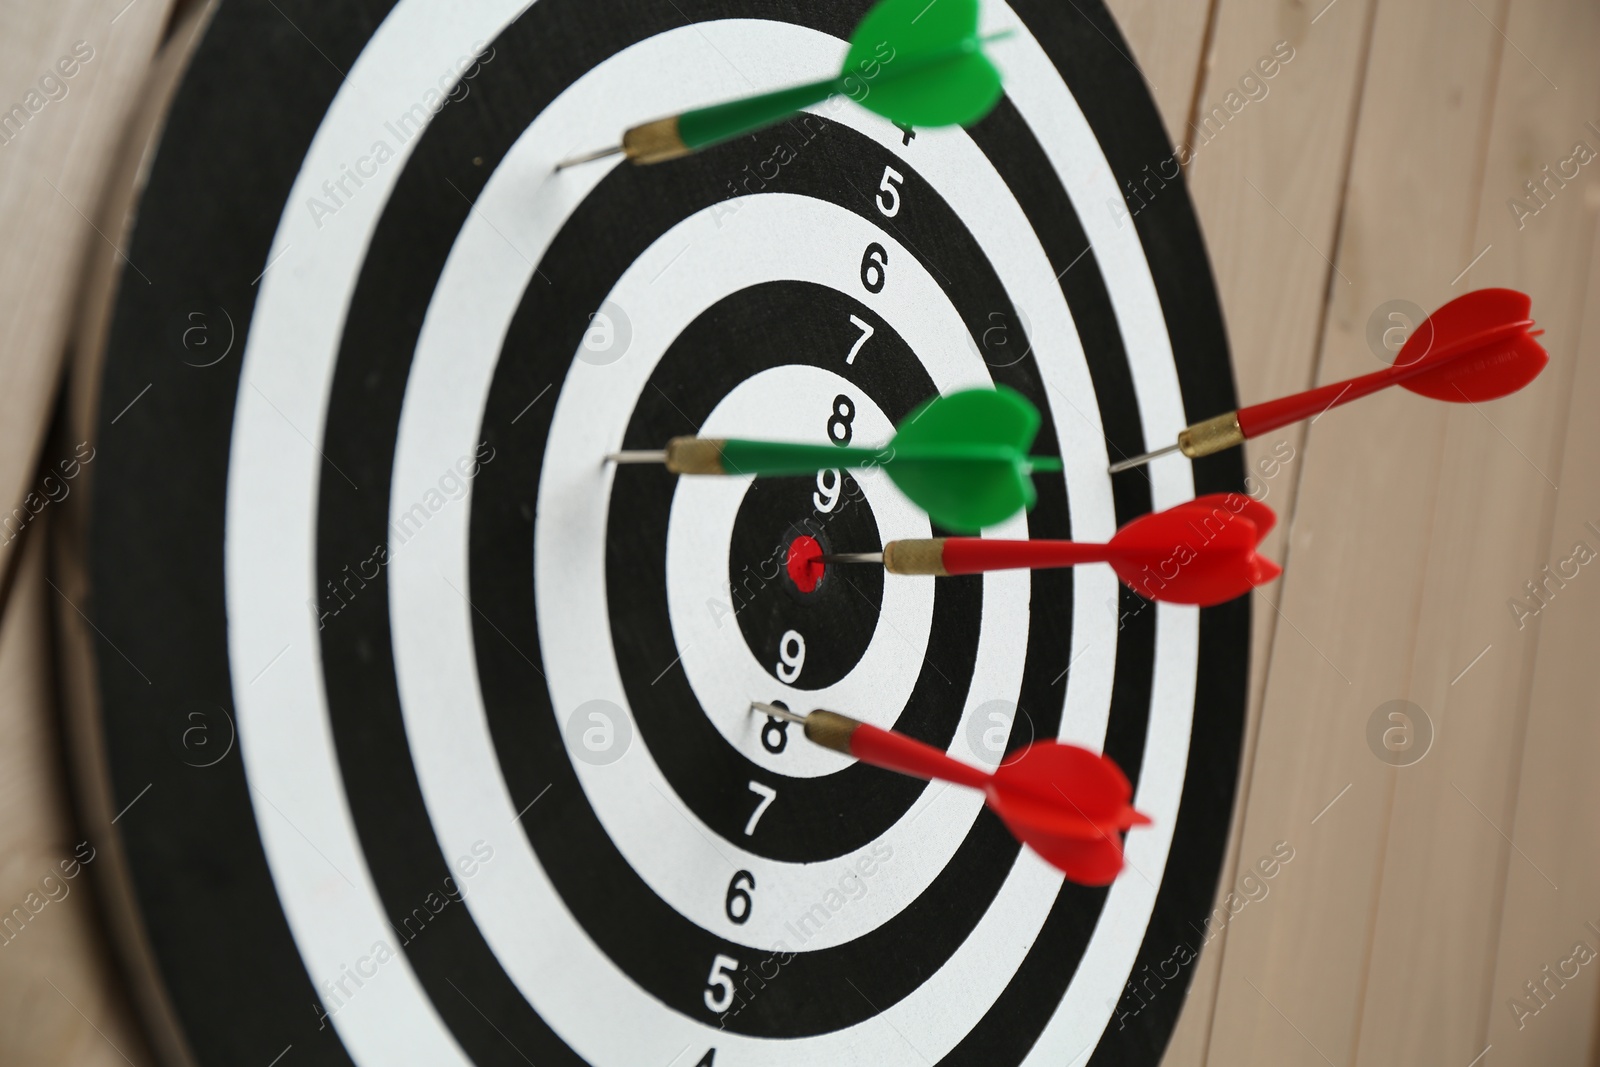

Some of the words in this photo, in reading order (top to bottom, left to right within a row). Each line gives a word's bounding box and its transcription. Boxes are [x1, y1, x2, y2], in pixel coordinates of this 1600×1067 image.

[876, 165, 903, 218] 5
[860, 242, 888, 294] 6
[846, 315, 875, 365] 7
[827, 394, 856, 449] 8
[813, 467, 842, 513] 9
[776, 630, 806, 684] 9
[761, 700, 791, 755] 8
[745, 781, 777, 836] 7
[725, 869, 756, 925] 6
[703, 954, 739, 1013] 5
